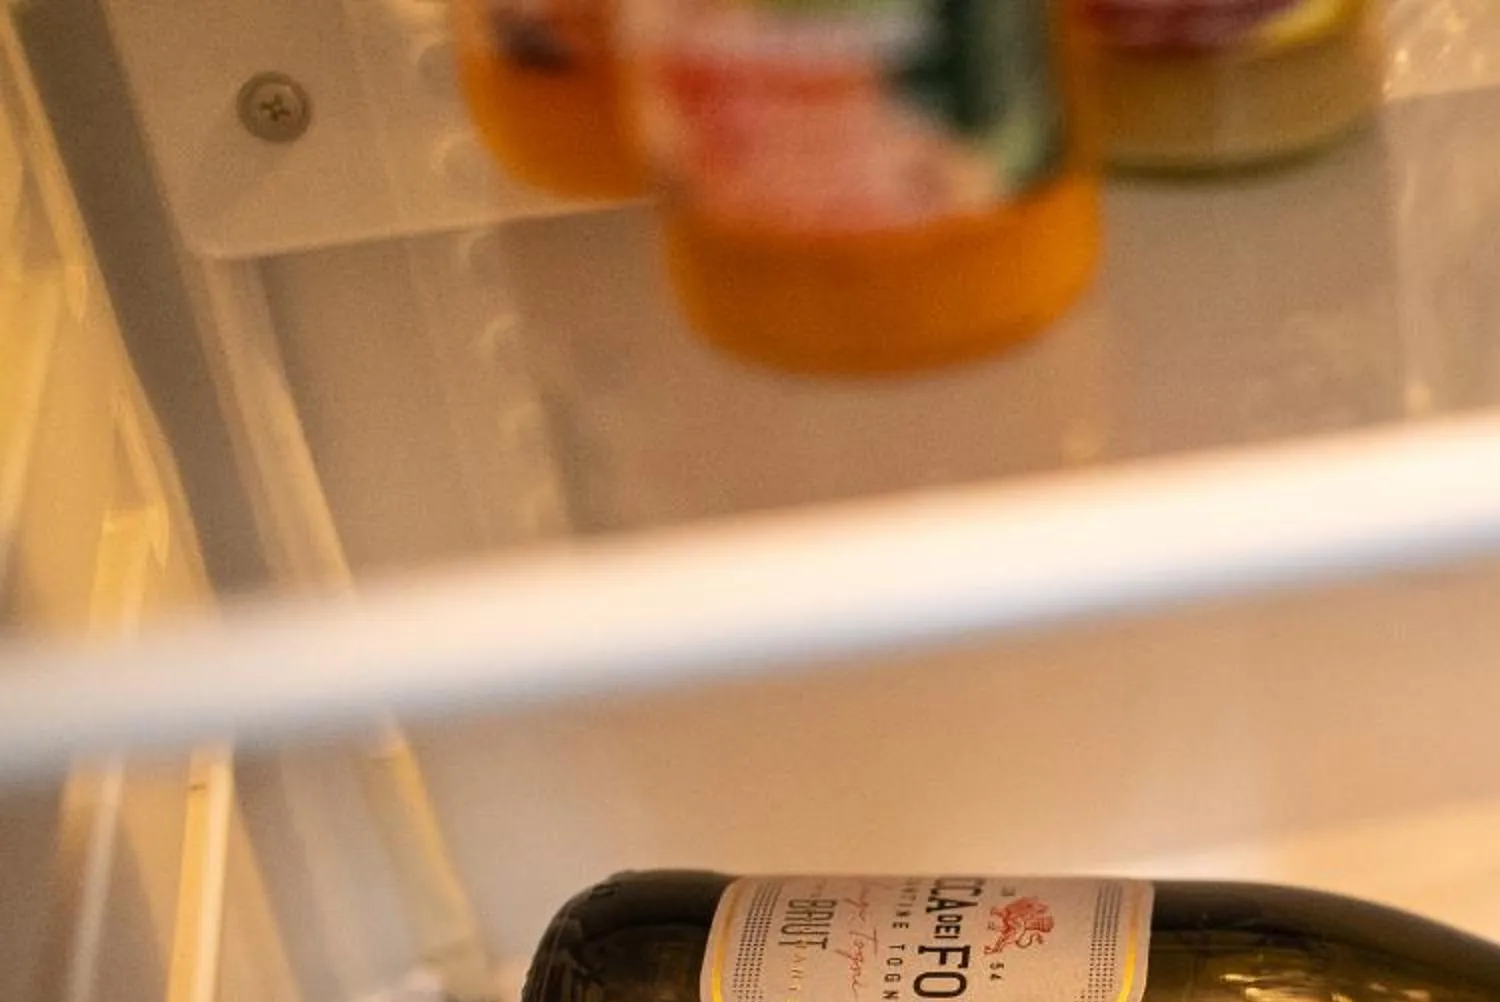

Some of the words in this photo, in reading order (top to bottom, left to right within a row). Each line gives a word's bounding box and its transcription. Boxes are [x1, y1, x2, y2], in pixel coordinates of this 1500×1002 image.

[778, 899, 838, 950] BRUT
[933, 914, 963, 939] DEI
[988, 962, 1005, 982] 54
